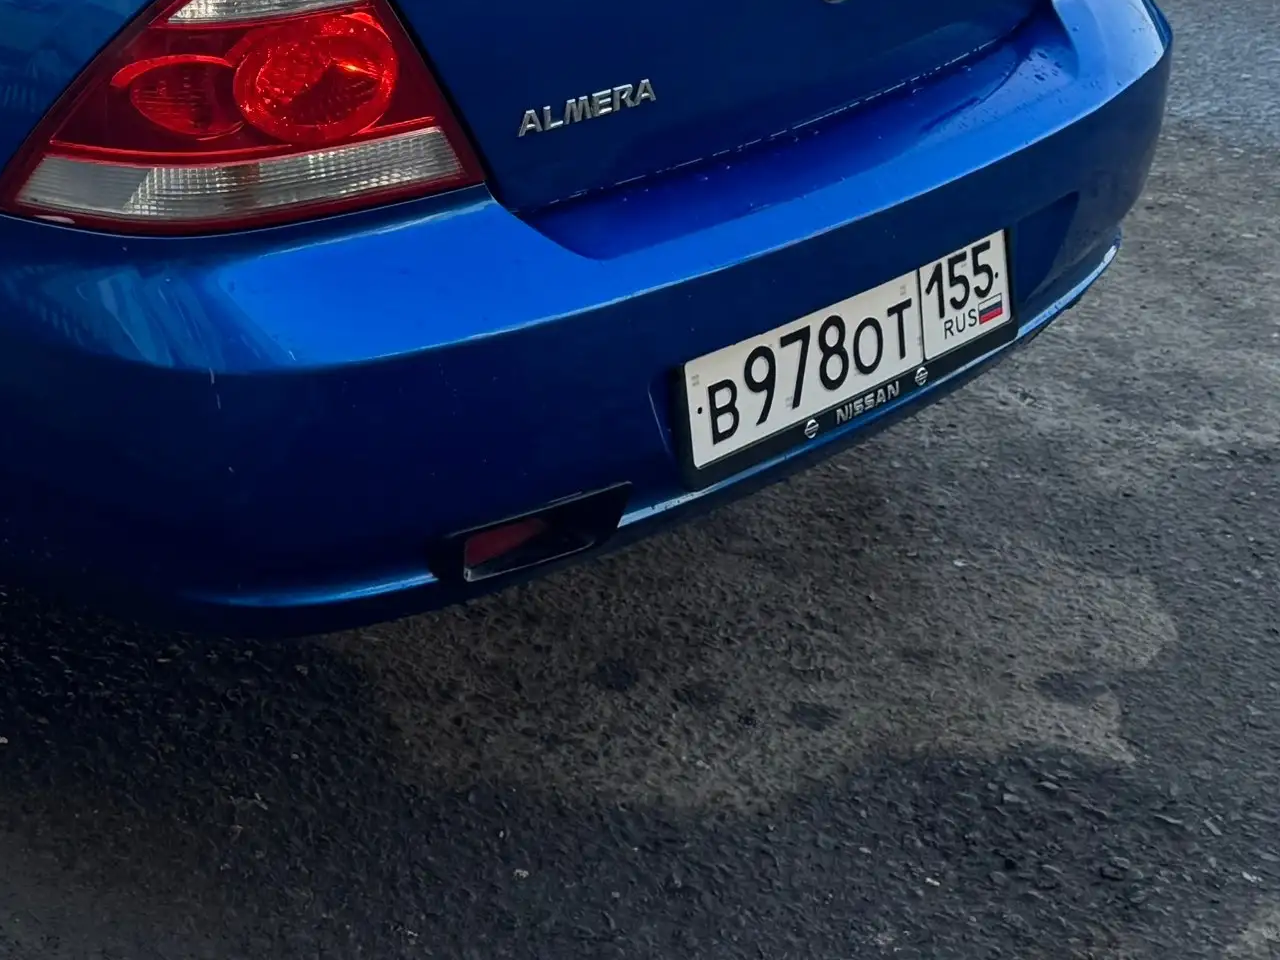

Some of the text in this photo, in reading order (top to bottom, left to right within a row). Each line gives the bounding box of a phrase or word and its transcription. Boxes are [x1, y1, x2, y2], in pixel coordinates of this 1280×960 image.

[518, 78, 657, 138] ALMERA
[925, 240, 995, 320] 155
[943, 307, 978, 341] RUS
[836, 380, 900, 425] NISSAN
